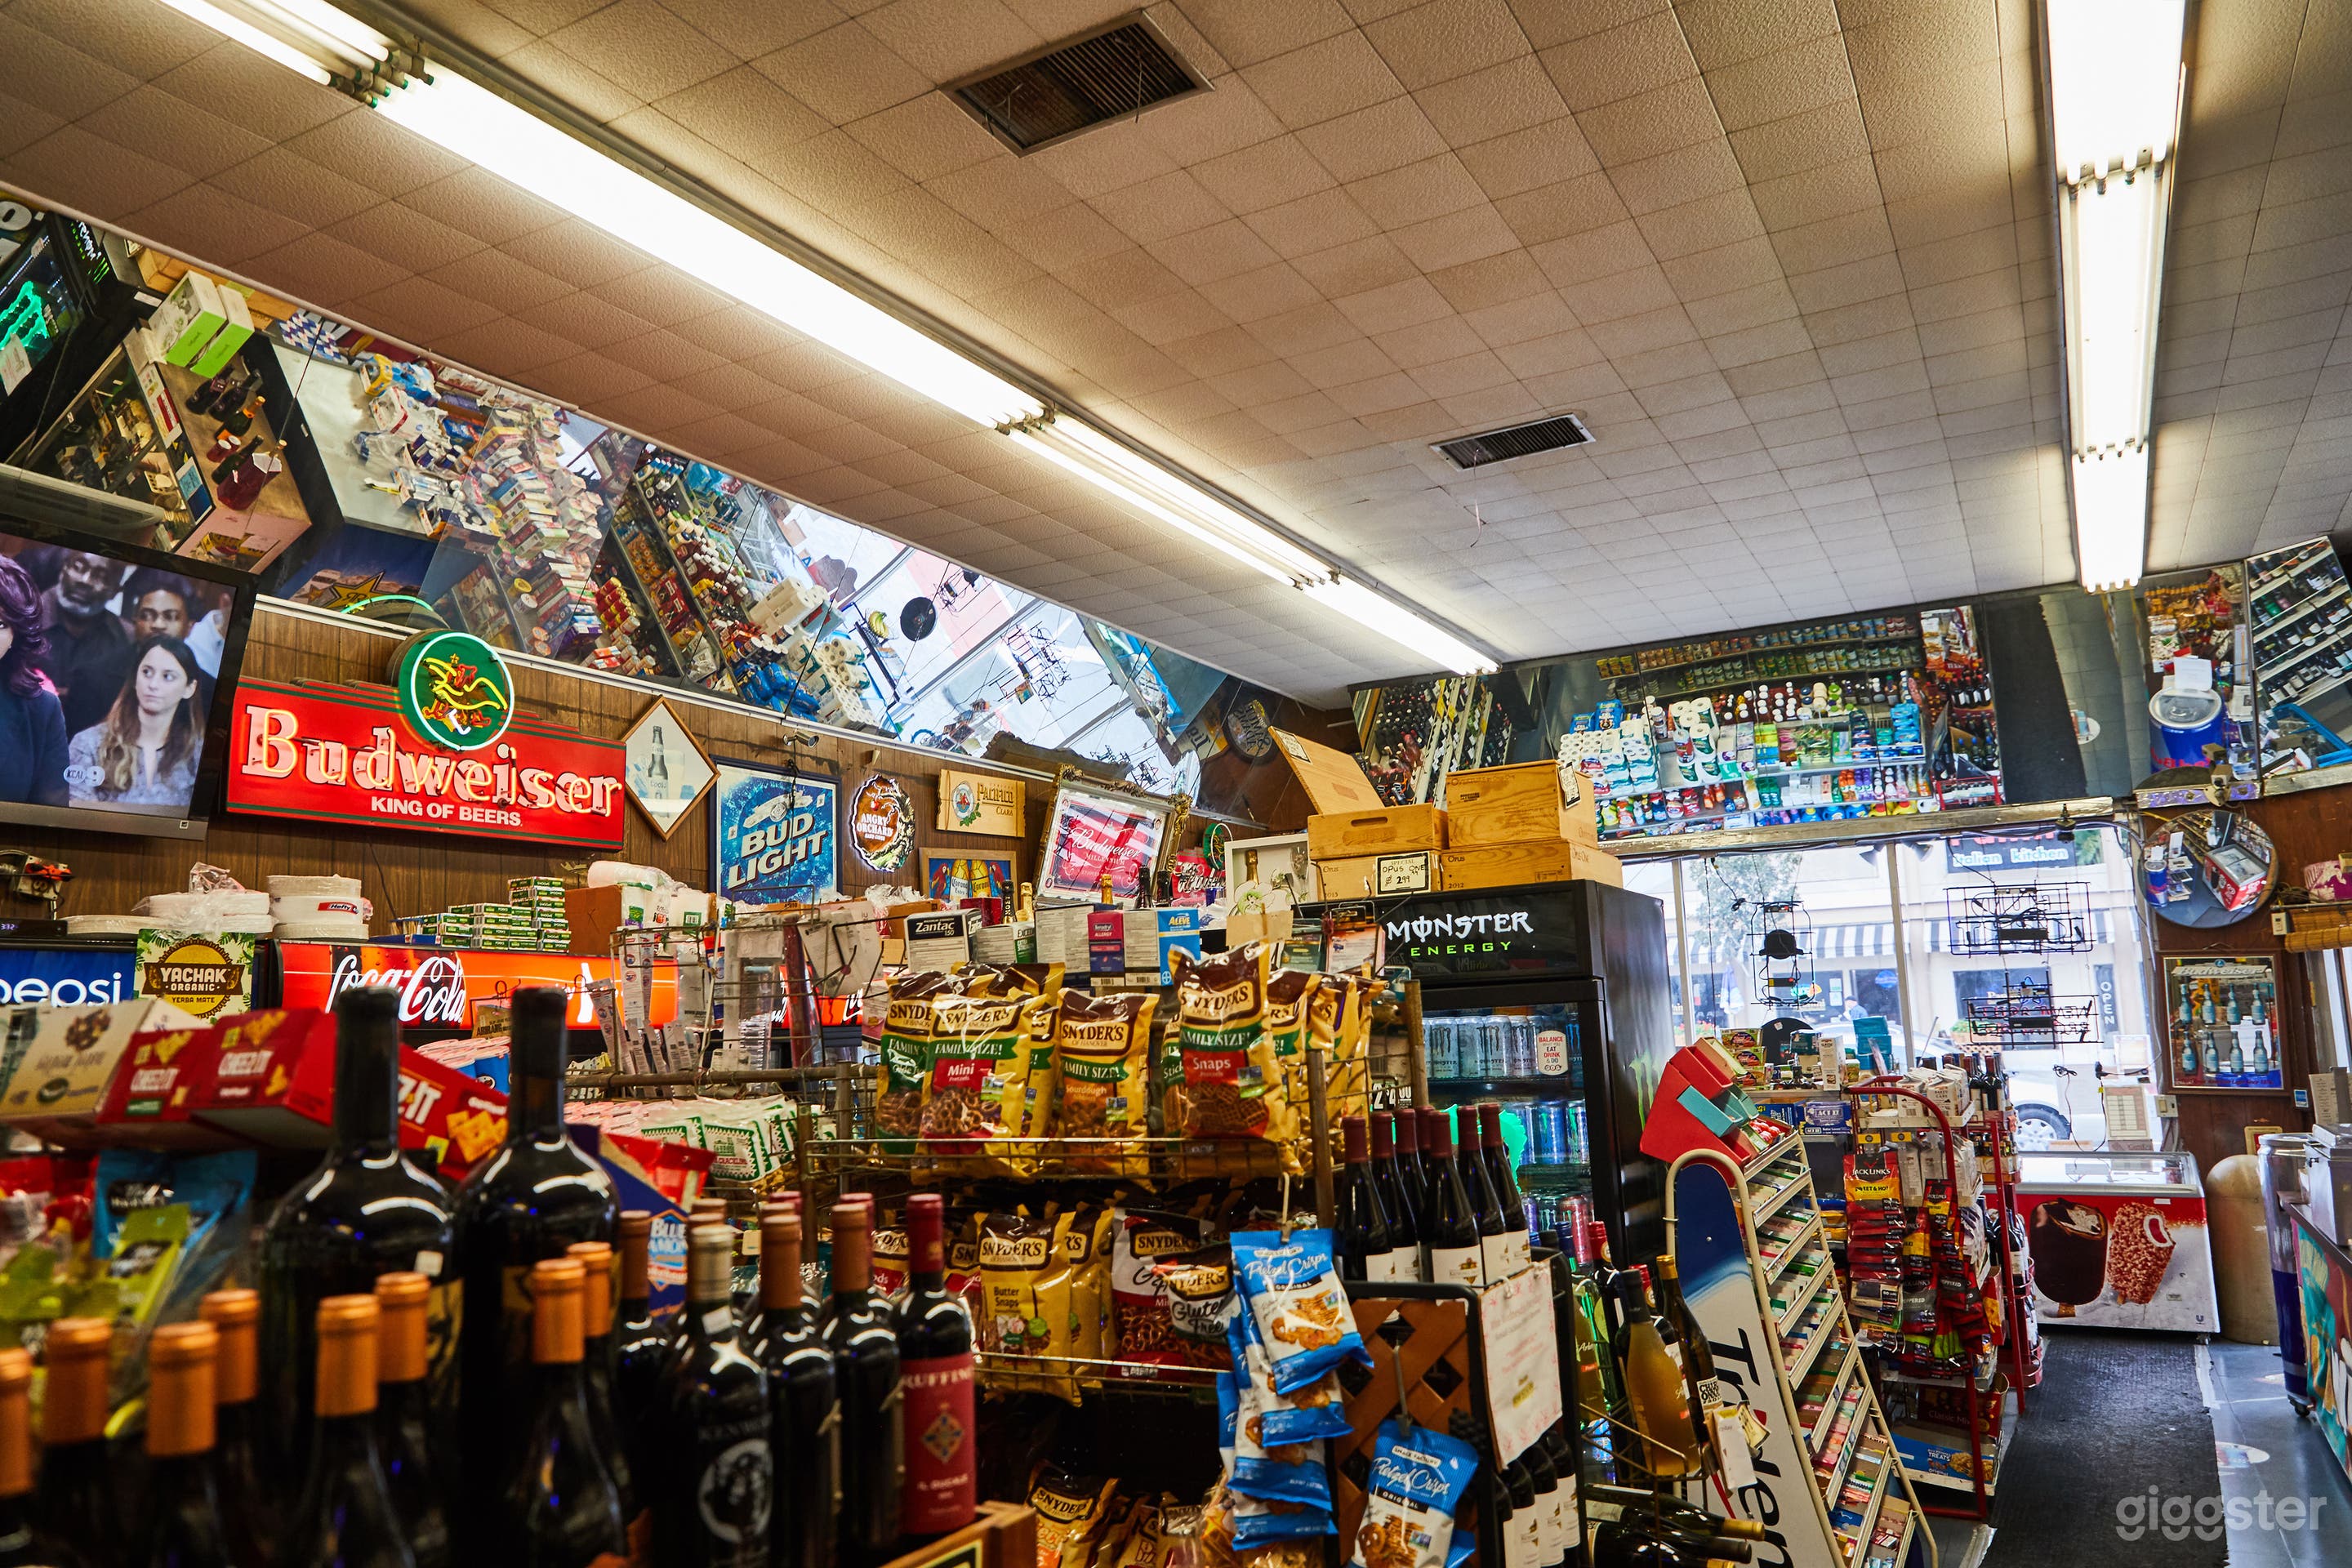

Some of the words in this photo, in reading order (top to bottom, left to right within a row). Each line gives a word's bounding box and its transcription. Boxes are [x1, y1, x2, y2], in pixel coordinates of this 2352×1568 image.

[242, 706, 622, 817] Budweiser
[67, 769, 83, 779] KCAL
[372, 796, 423, 815] KING
[426, 803, 453, 819] OF
[459, 806, 522, 826] BEERS
[996, 806, 1013, 817] CLARA
[861, 813, 888, 826] ANGRY
[741, 813, 814, 859] BUD
[857, 822, 893, 836] ORCHARD
[1069, 827, 1143, 858] Budweiser
[728, 831, 827, 889] LIGHT
[1953, 851, 2003, 867] italian
[2010, 846, 2069, 863] kitchen
[328, 902, 352, 911] Hefty
[915, 921, 956, 933] Zantac
[1169, 916, 1192, 926] ALEVE
[1387, 911, 1534, 943] MONSTER
[1410, 941, 1512, 957] ENERGY
[160, 967, 229, 982] YACHAK
[171, 982, 215, 991] ORGANIC
[2100, 982, 2116, 1025] OPEN
[1062, 1024, 1125, 1042] SNYDER'S
[947, 1062, 975, 1076] Mini
[1091, 1066, 1120, 1078] SIZE!
[1193, 1058, 1231, 1071] Snaps
[1066, 1083, 1107, 1098] Sourdough
[982, 1241, 1042, 1256] SNYDER'S
[1244, 1259, 1288, 1280] Pretzel
[1288, 1253, 1328, 1276] Crisps
[994, 1286, 1020, 1297] Butter
[995, 1298, 1020, 1307] Snaps
[1187, 1317, 1223, 1333] Free
[1928, 1410, 1955, 1422] Classic
[1928, 1451, 1951, 1463] TREATS
[1373, 1456, 1418, 1489] Pretzel
[1411, 1469, 1451, 1499] Crisps
[1382, 1491, 1419, 1509] ORIGAL
